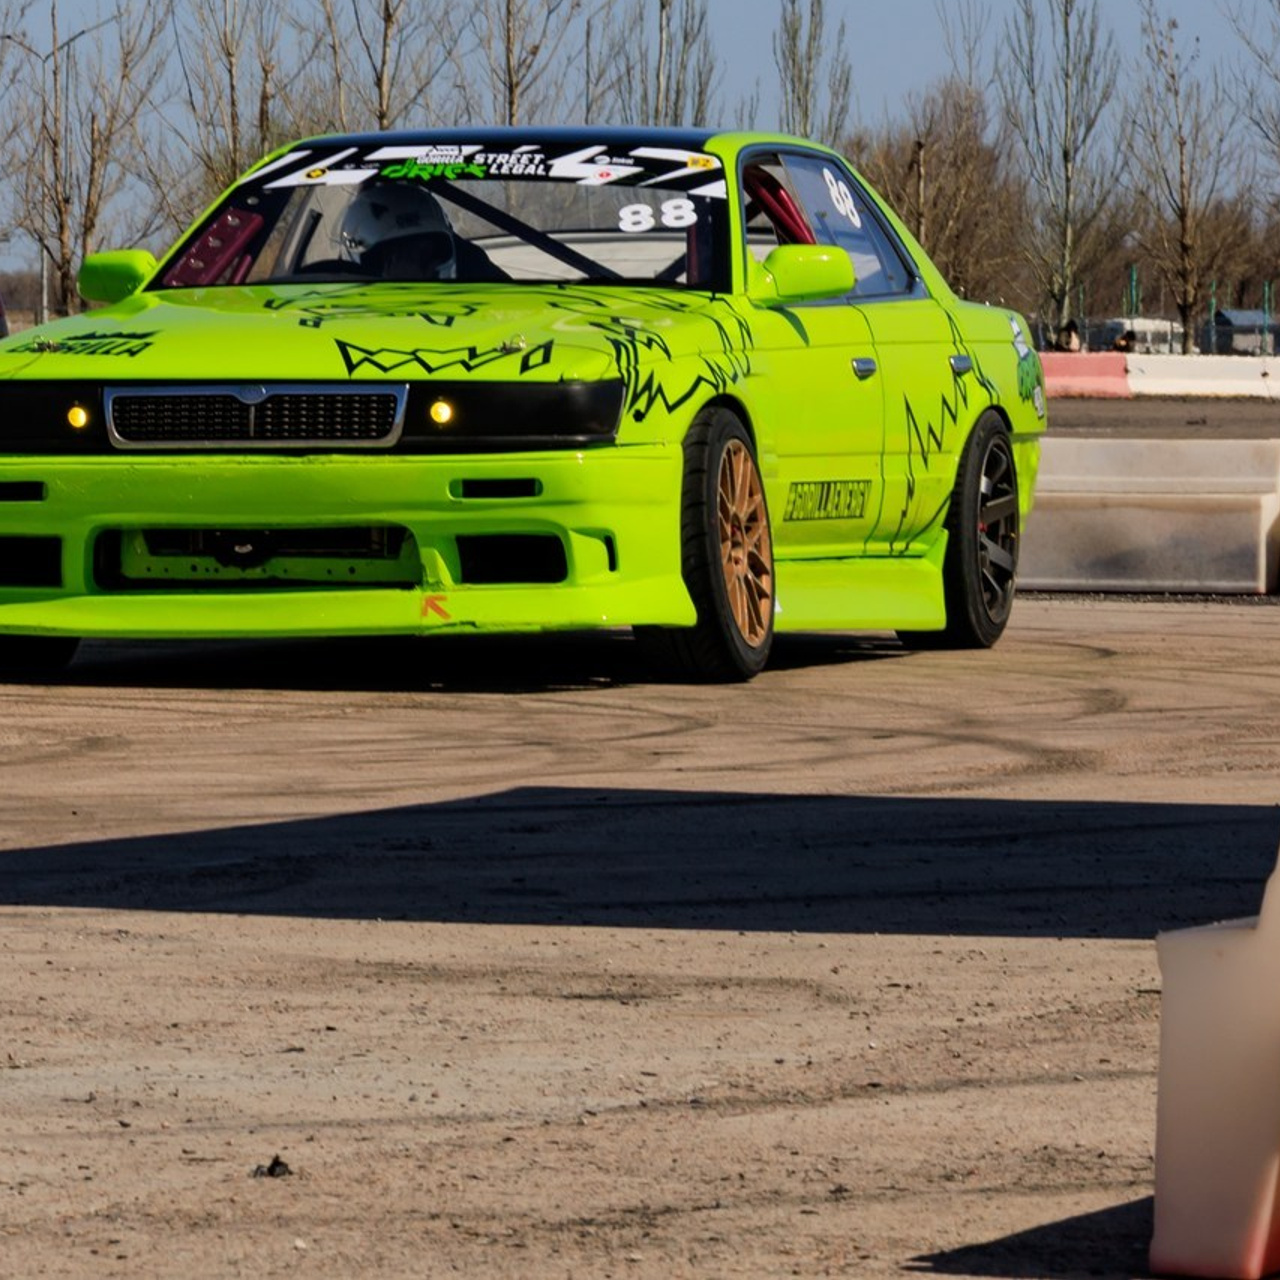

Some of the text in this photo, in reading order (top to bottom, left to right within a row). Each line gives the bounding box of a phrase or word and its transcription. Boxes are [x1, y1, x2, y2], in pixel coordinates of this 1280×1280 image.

[474, 153, 546, 165] STREET
[489, 163, 547, 176] LEGAL
[822, 167, 862, 229] 88
[618, 198, 699, 233] 88
